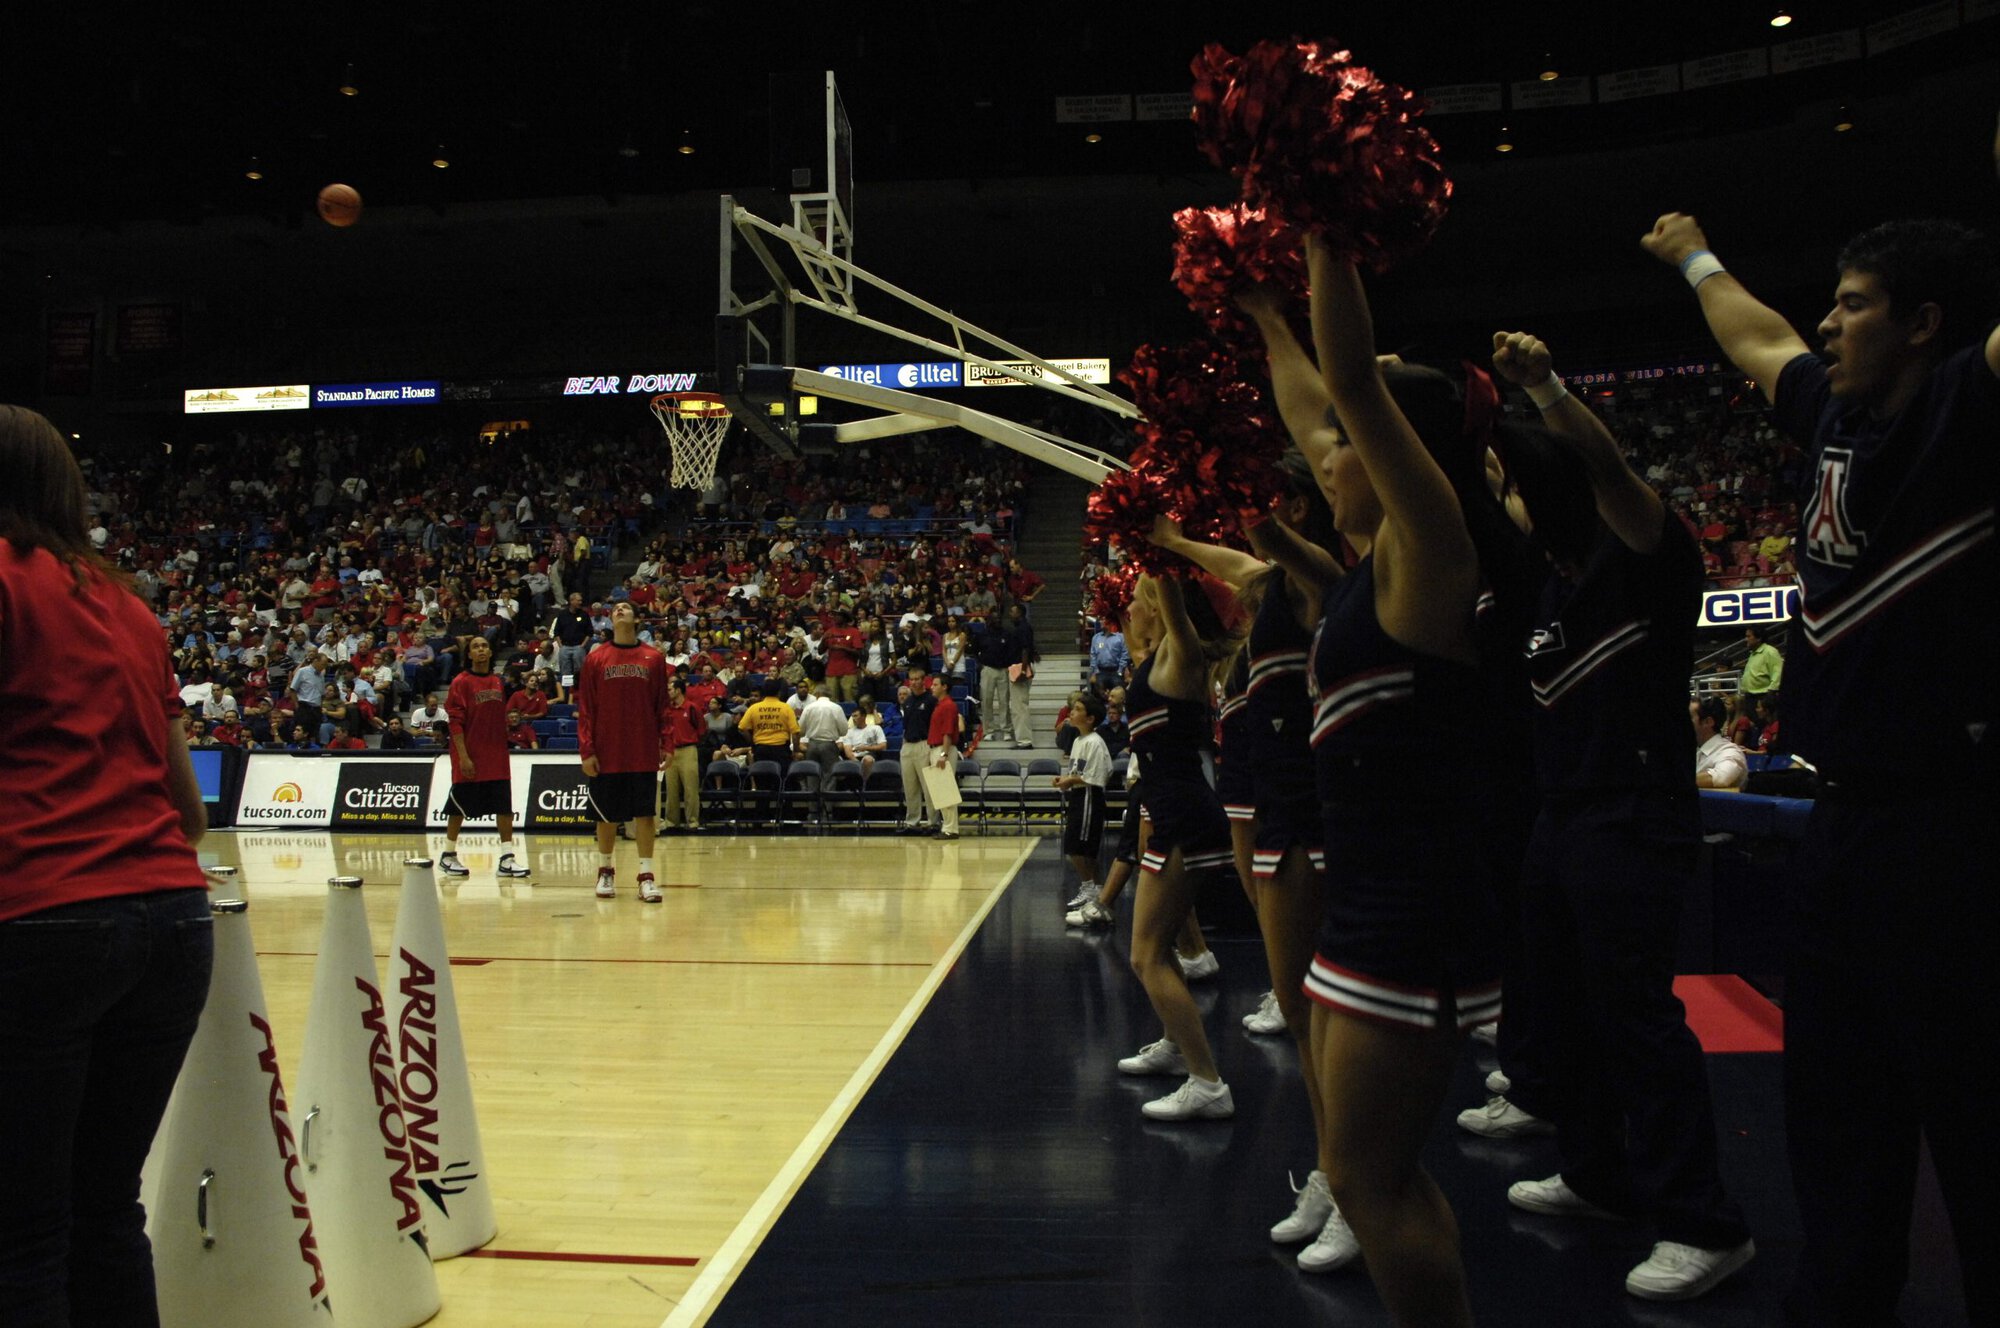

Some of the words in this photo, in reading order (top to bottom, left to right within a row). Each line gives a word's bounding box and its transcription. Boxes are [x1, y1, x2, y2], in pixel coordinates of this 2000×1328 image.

[909, 363, 959, 383] alltel
[1077, 362, 1107, 371] Bakery
[317, 389, 364, 402] STANDARD
[365, 387, 400, 400] PACIFIC
[402, 385, 436, 399] HOMES
[563, 376, 619, 395] BEAR
[627, 373, 697, 393] DOWN
[1803, 446, 1868, 569] A
[604, 663, 650, 681] ARIZONA
[383, 782, 420, 793] Tucson
[345, 787, 419, 809] Citizen
[538, 789, 588, 810] Citiz
[243, 805, 326, 819] tucson.com
[341, 813, 358, 821] Miss
[365, 812, 380, 822] day.
[381, 813, 398, 821] Miss
[405, 812, 417, 821] lot.
[535, 815, 553, 823] Miss
[399, 946, 439, 1174] ARIZONA
[355, 976, 421, 1231] ARIZONA
